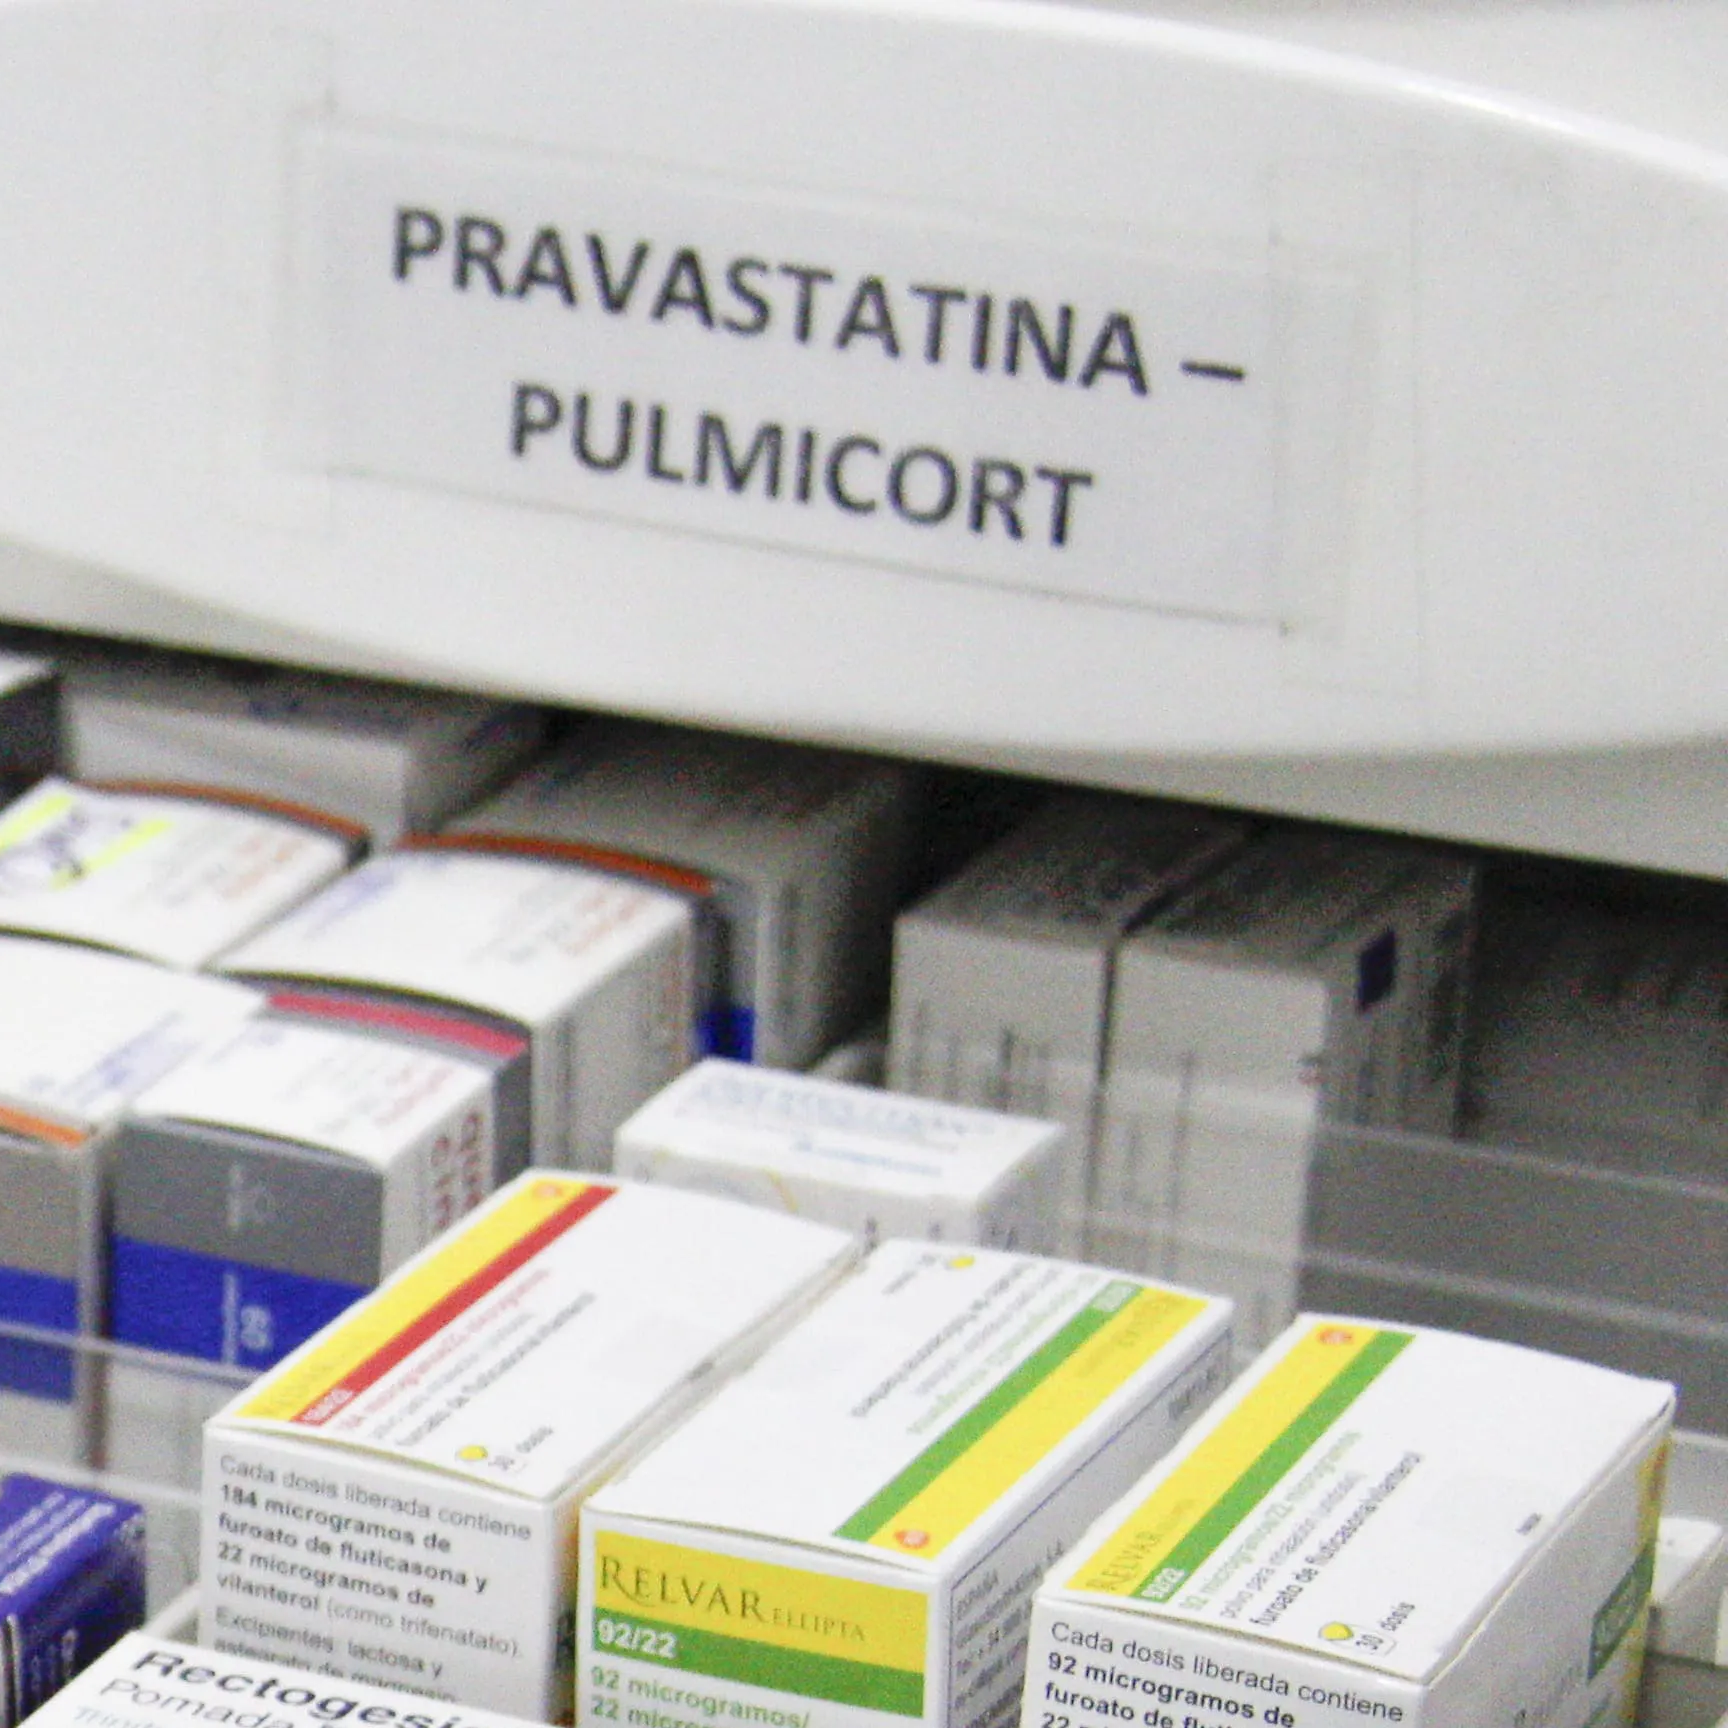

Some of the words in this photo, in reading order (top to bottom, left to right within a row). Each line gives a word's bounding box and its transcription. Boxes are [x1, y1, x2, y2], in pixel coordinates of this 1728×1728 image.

[394, 207, 1150, 397] PRAVASTATINA
[508, 380, 1094, 547] PULMICORT
[220, 1454, 275, 1484] Cada
[282, 1471, 339, 1499] dosis
[346, 1484, 431, 1520] liberada
[437, 1505, 532, 1541] contiene
[221, 1484, 258, 1509] 184
[264, 1499, 415, 1546] microgramos
[422, 1532, 451, 1553] de
[217, 1541, 242, 1564] 22
[249, 1552, 399, 1601] microgramos
[407, 1588, 435, 1608] de
[218, 1512, 298, 1548] furoato
[306, 1536, 332, 1556] de
[340, 1541, 468, 1586] fluticasona
[475, 1575, 488, 1596] y
[217, 1573, 319, 1610] vilanterol
[600, 1555, 773, 1624] RELVAR
[348, 1639, 424, 1673] lactosa
[431, 1659, 443, 1678] y
[597, 1618, 677, 1659] 92/22
[1051, 1621, 1113, 1654] Cada
[1122, 1642, 1184, 1672] dosis
[1193, 1655, 1289, 1697] liberada
[1298, 1683, 1403, 1723] contiene
[591, 1665, 620, 1690] 92
[591, 1696, 620, 1720] 22
[1044, 1682, 1135, 1721] furoato
[1048, 1652, 1076, 1676] 92
[1084, 1663, 1254, 1719] microgramos
[1264, 1707, 1296, 1728] de
